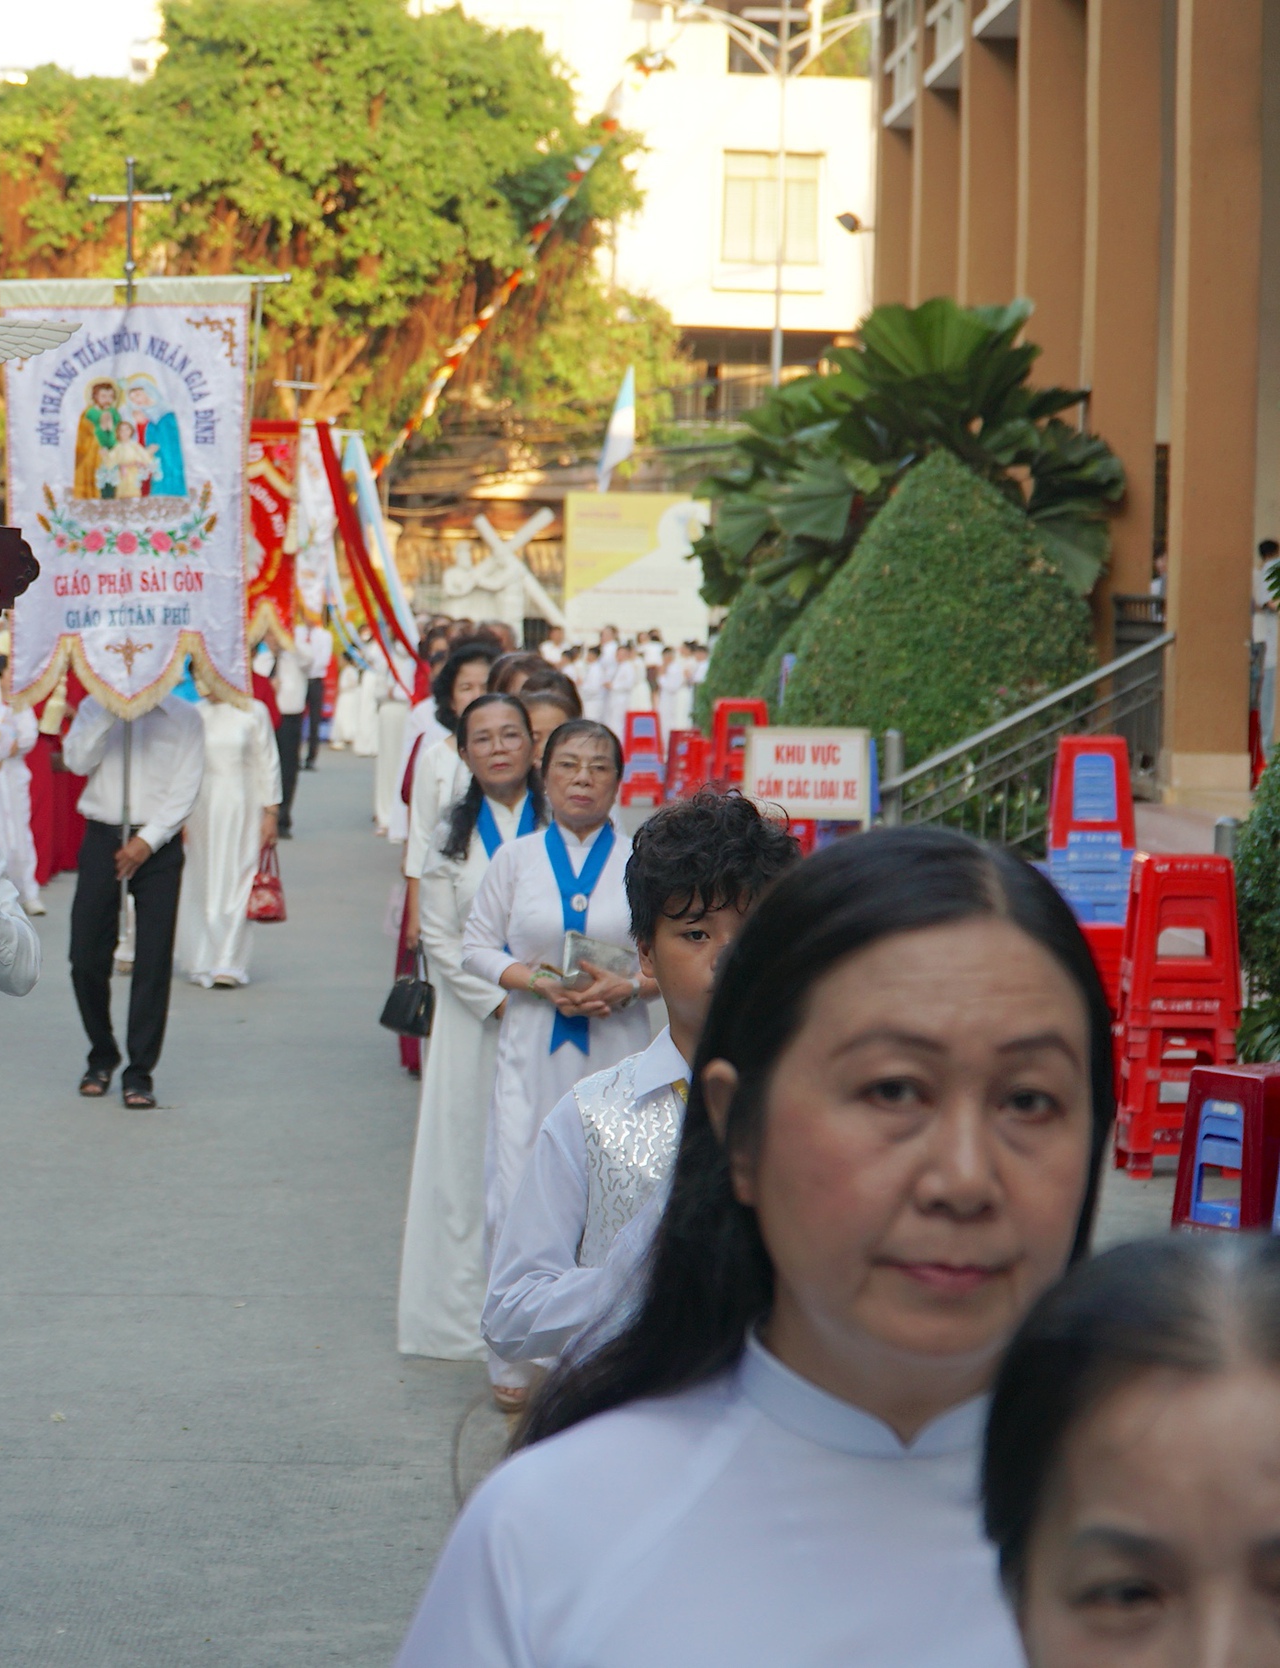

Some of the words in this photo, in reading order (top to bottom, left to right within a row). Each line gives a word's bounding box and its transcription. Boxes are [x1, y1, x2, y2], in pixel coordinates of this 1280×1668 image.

[184, 370, 211, 403] GIA
[54, 569, 91, 597] GIÁO
[140, 565, 167, 592] SÀI
[174, 565, 204, 592] GÒN
[65, 605, 101, 629] GIÁO
[163, 602, 190, 626] PHÚ
[774, 744, 806, 765] KHU
[811, 742, 841, 770] VỰC
[757, 771, 783, 798] CẤM
[787, 776, 810, 799] CÁC
[813, 779, 839, 805] LOẠI
[843, 779, 858, 799] XE
